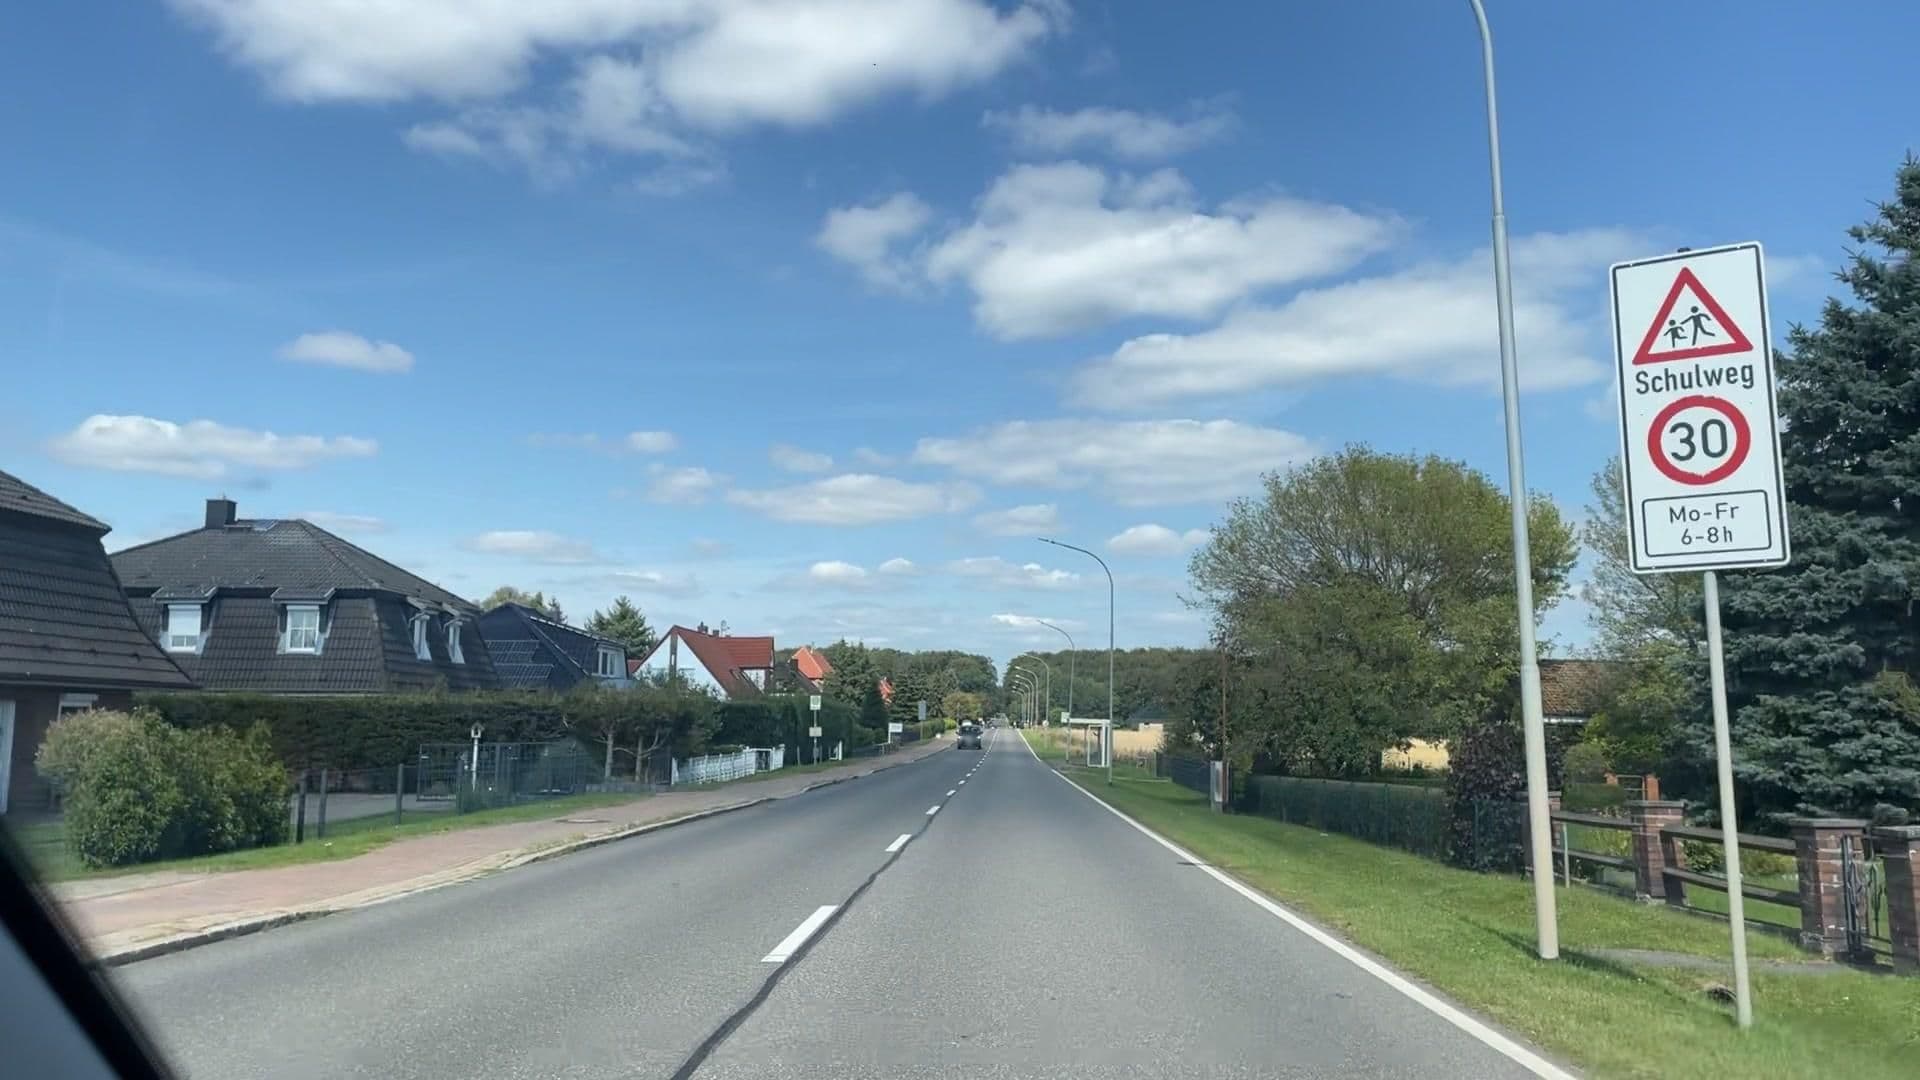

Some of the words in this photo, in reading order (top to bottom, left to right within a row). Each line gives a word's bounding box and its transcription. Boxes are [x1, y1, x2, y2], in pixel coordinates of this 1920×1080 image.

[1635, 363, 1754, 395] Schulweg
[1669, 419, 1728, 461] 30
[1669, 503, 1739, 524] Mo-Fr
